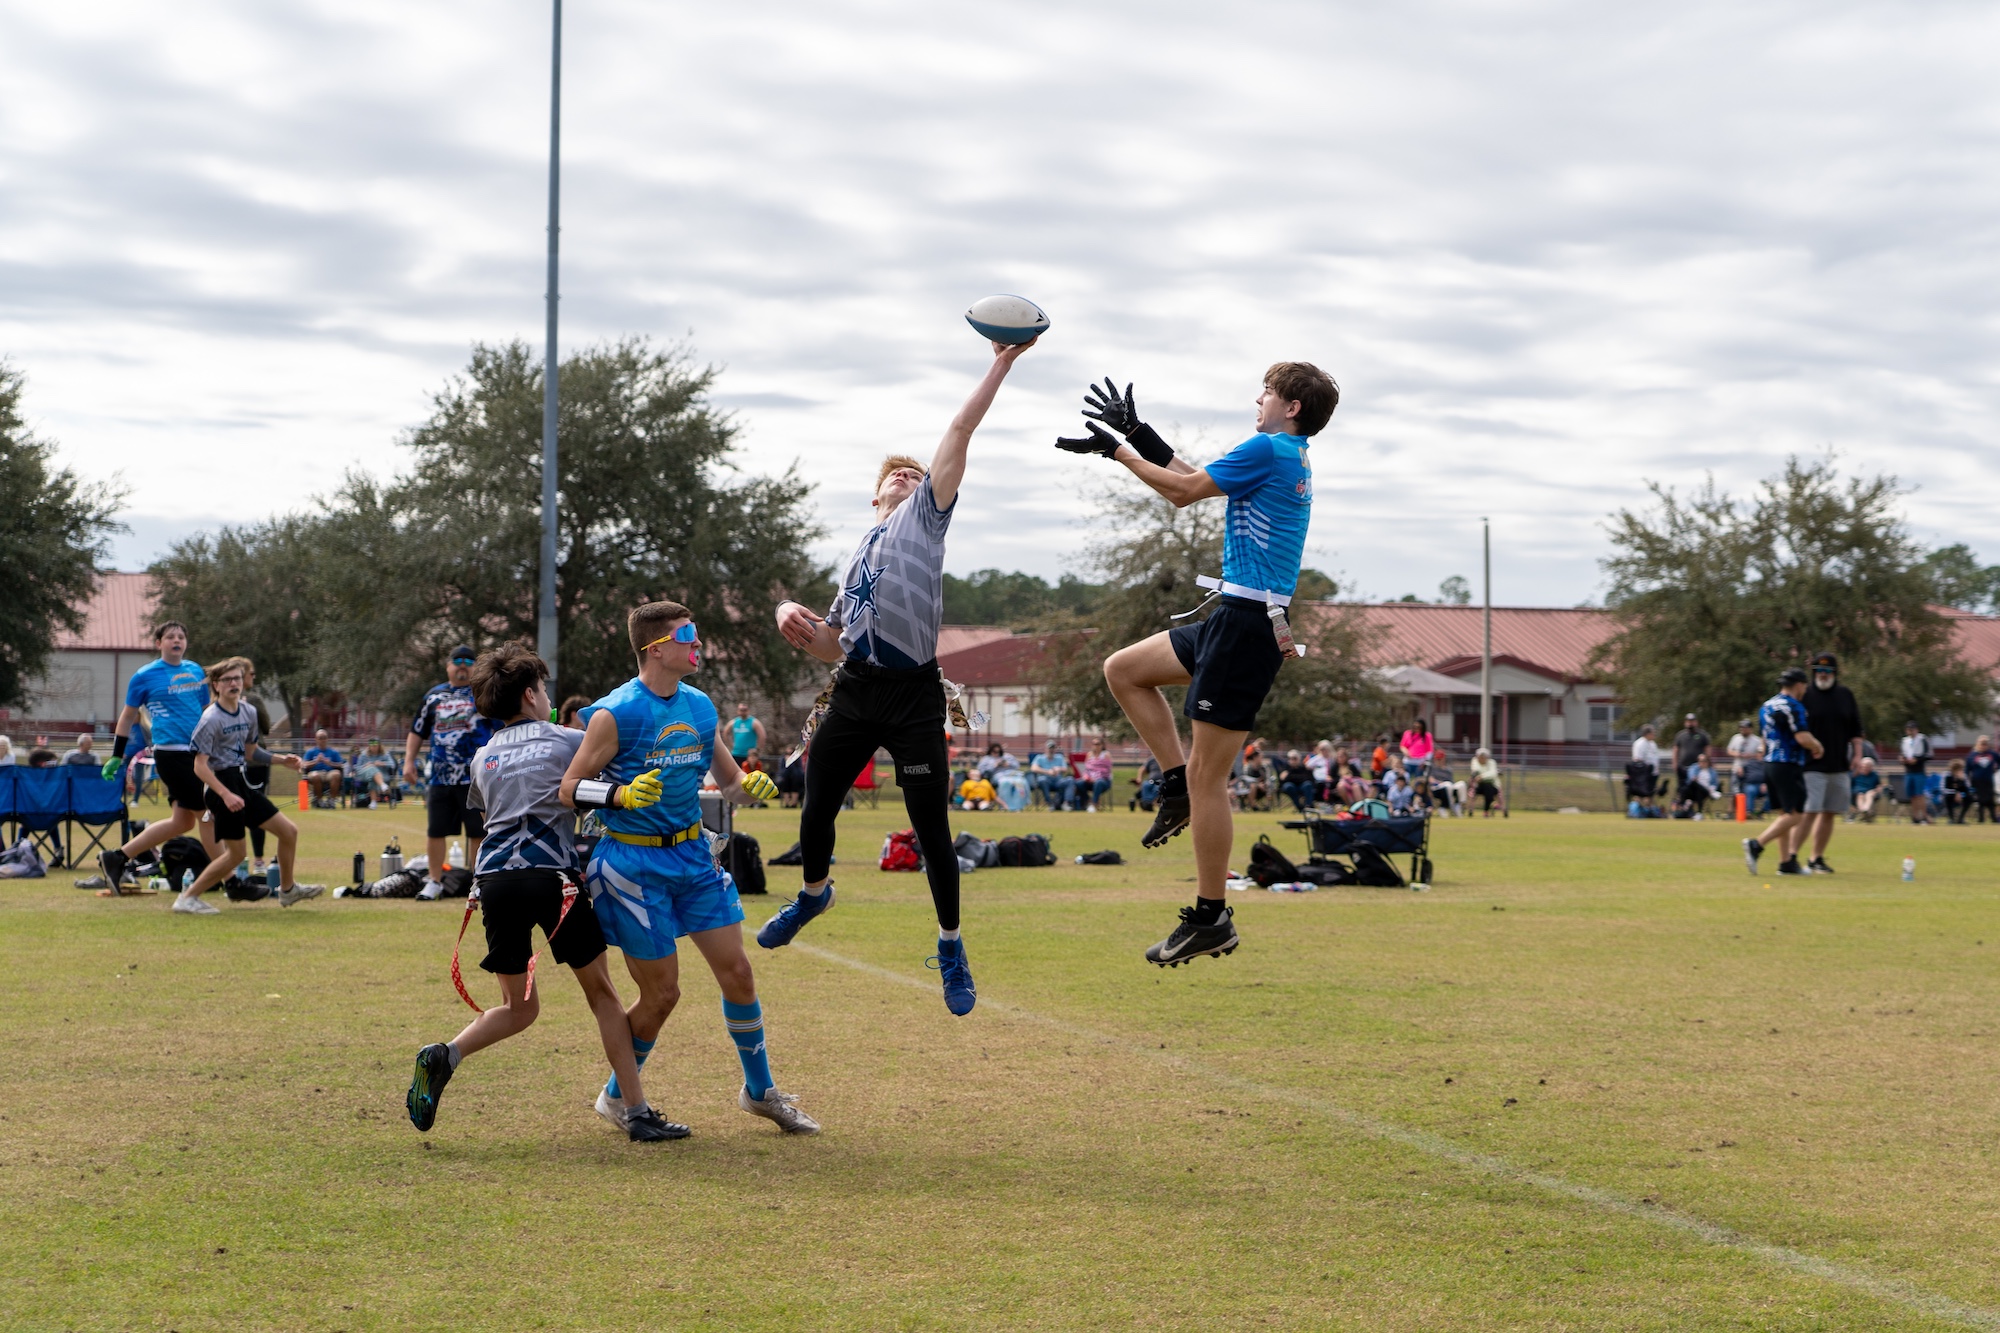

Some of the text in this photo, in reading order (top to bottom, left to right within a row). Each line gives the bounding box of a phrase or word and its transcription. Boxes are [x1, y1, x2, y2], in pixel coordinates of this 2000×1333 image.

[495, 723, 541, 746] KING
[496, 741, 553, 772] FLAG
[643, 751, 701, 767] CHARGERS
[645, 744, 704, 759] LOS ANGELES
[485, 760, 498, 770] NFL
